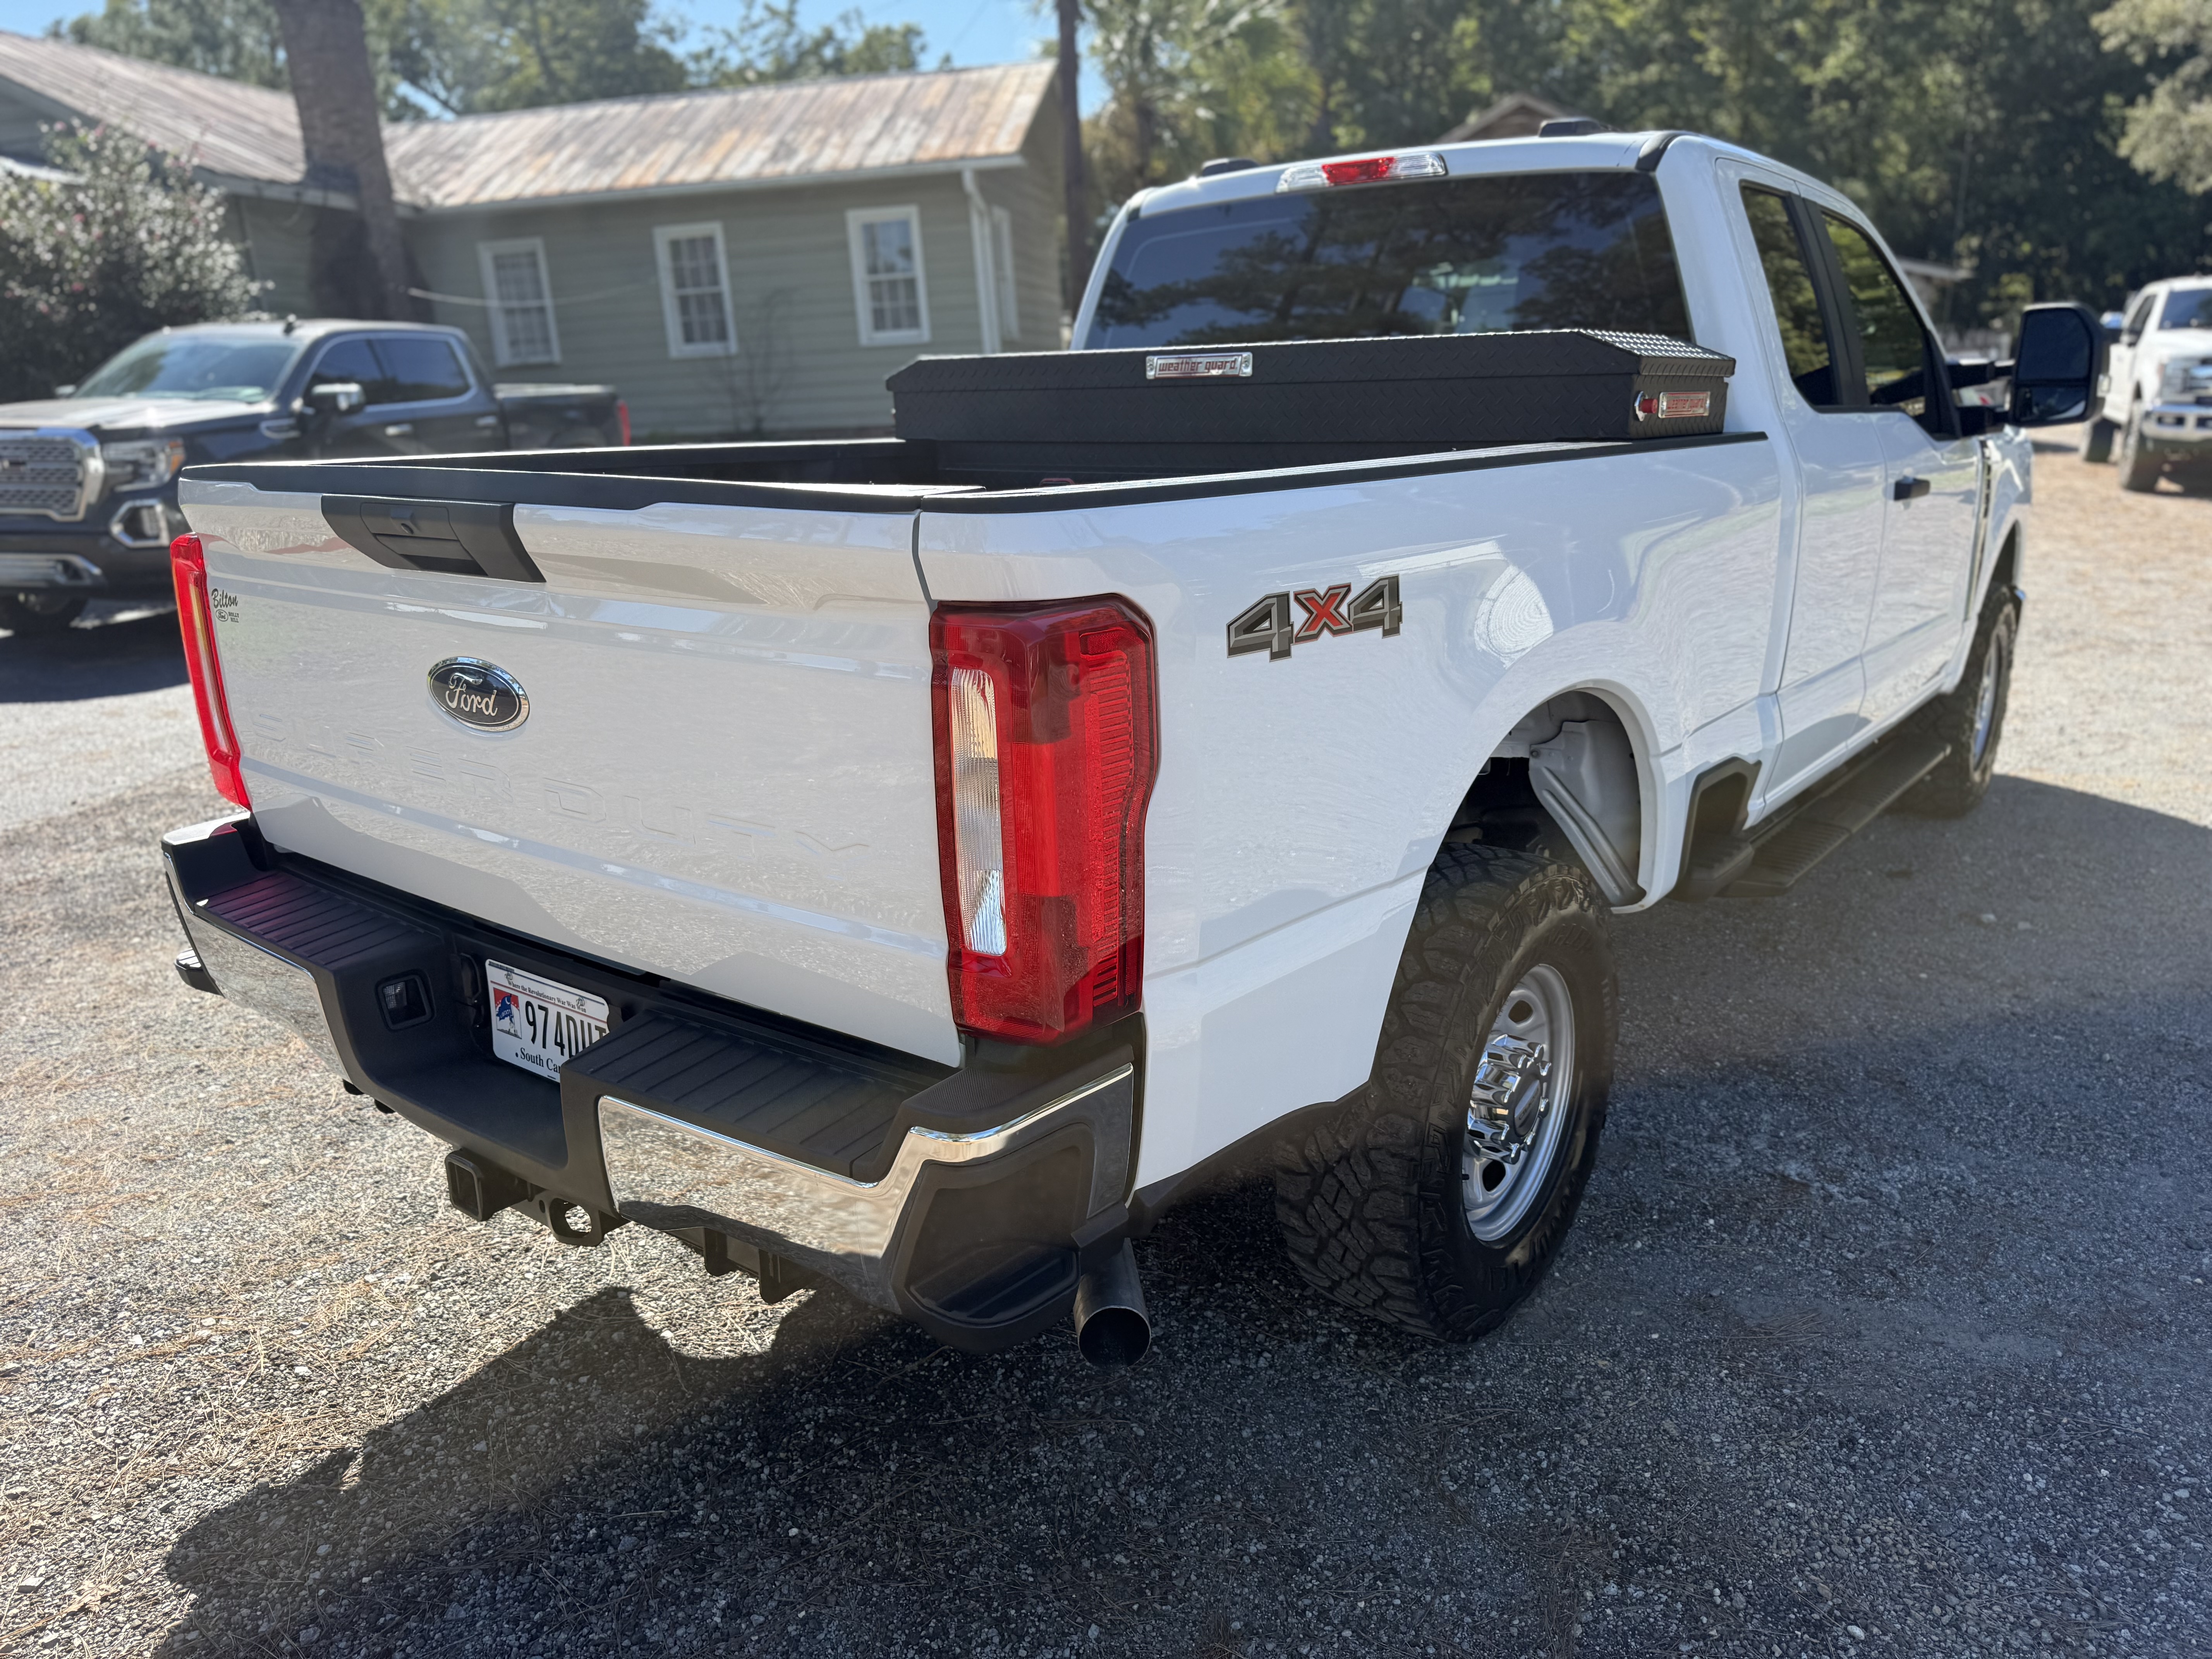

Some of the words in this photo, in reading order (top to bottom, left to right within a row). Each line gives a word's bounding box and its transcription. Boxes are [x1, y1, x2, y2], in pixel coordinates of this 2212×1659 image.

[1159, 360, 1202, 372] weather
[1205, 357, 1238, 371] guard
[211, 588, 238, 608] Bilton
[1226, 574, 1403, 663] 4X4
[445, 673, 498, 716] Ford
[542, 776, 871, 881] DUTY
[507, 980, 520, 989] Where
[528, 987, 556, 1003] Revolutionary
[556, 996, 566, 1006] War
[566, 1000, 575, 1009] Was
[576, 1005, 586, 1013] Won
[520, 1047, 544, 1068] South
